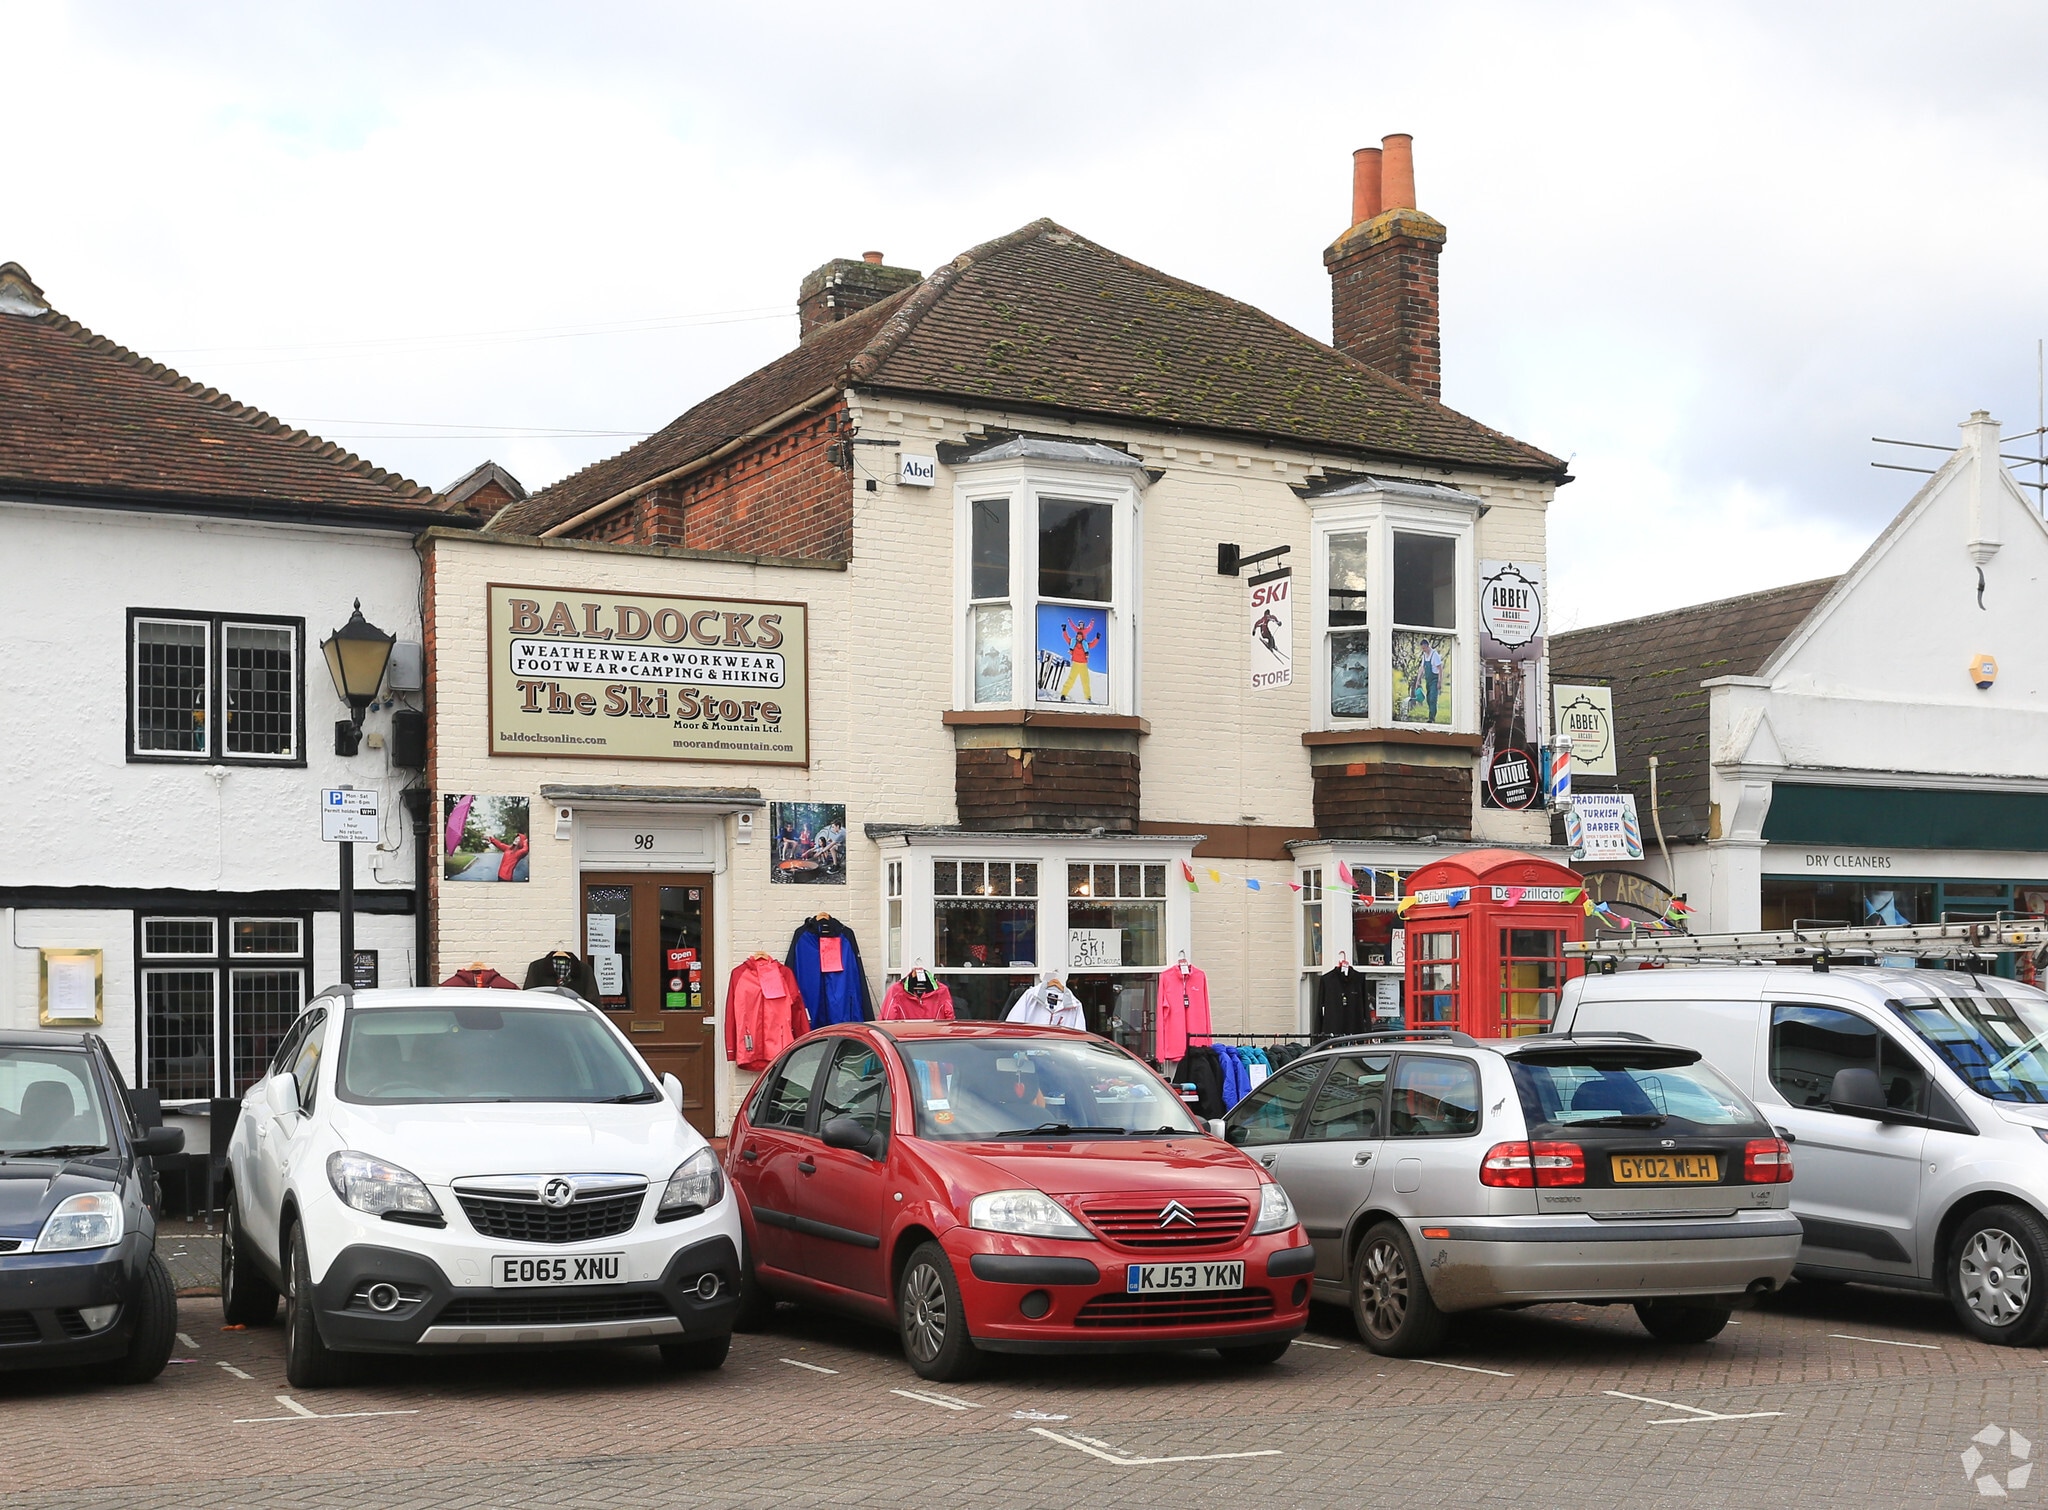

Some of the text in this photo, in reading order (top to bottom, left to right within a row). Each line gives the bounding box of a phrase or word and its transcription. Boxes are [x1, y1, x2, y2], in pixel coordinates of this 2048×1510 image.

[903, 461, 934, 479] Abel
[1251, 581, 1289, 608] SKI
[1492, 586, 1528, 609] ABBEY
[1502, 610, 1521, 619] ARCADE
[508, 598, 784, 650] BALDOCKS
[521, 645, 775, 669] WEATHERWEAR WORKWEAR
[517, 658, 779, 683] FOOTWEAR CAMPING & HIKING
[1252, 669, 1290, 688] STORE
[516, 680, 782, 724] The Ski Store
[673, 720, 782, 733] Moor & Mountain Ltd.
[1570, 713, 1599, 730] ABBEY
[500, 732, 793, 752] baldocksonline.com moorandmountain.com
[1577, 732, 1593, 740] ARCADE
[1494, 762, 1530, 786] UNIQUE
[1572, 795, 1626, 805] TRADITIONAL
[1583, 809, 1619, 819] TURKISH
[1586, 822, 1620, 832] BARBER
[634, 834, 654, 850] 98
[1806, 854, 1891, 869] DRY CLEANERS
[1071, 930, 1097, 942] ALL
[670, 950, 692, 961] Open
[1080, 941, 1105, 956] SKI
[1620, 1157, 1711, 1179] GY02 WLH
[503, 1257, 619, 1283] EO65 XNU
[1141, 1264, 1242, 1289] KJ53 YKN
